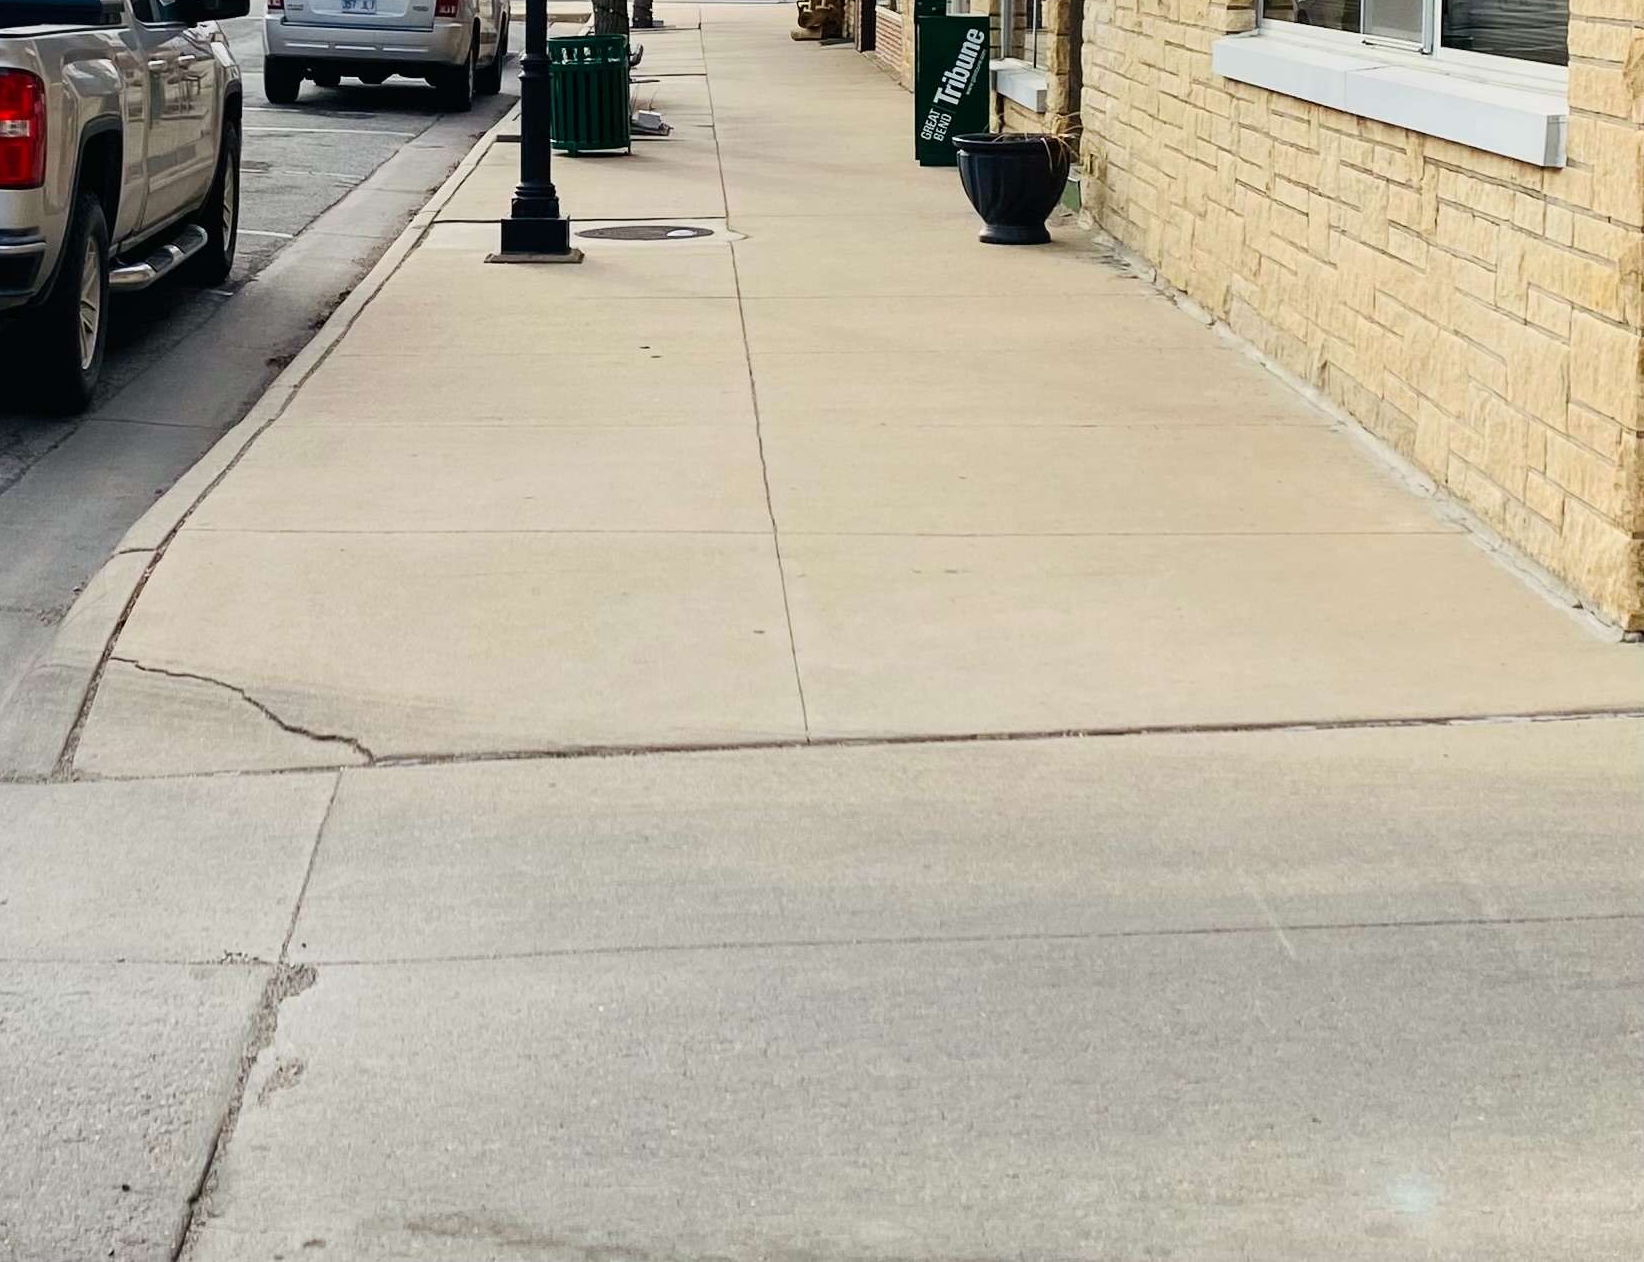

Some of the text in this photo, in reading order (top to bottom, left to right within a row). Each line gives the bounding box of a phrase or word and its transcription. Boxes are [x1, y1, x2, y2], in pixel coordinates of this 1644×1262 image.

[933, 28, 985, 106] Tribune
[920, 108, 941, 141] GREAT
[933, 113, 952, 142] BEND
